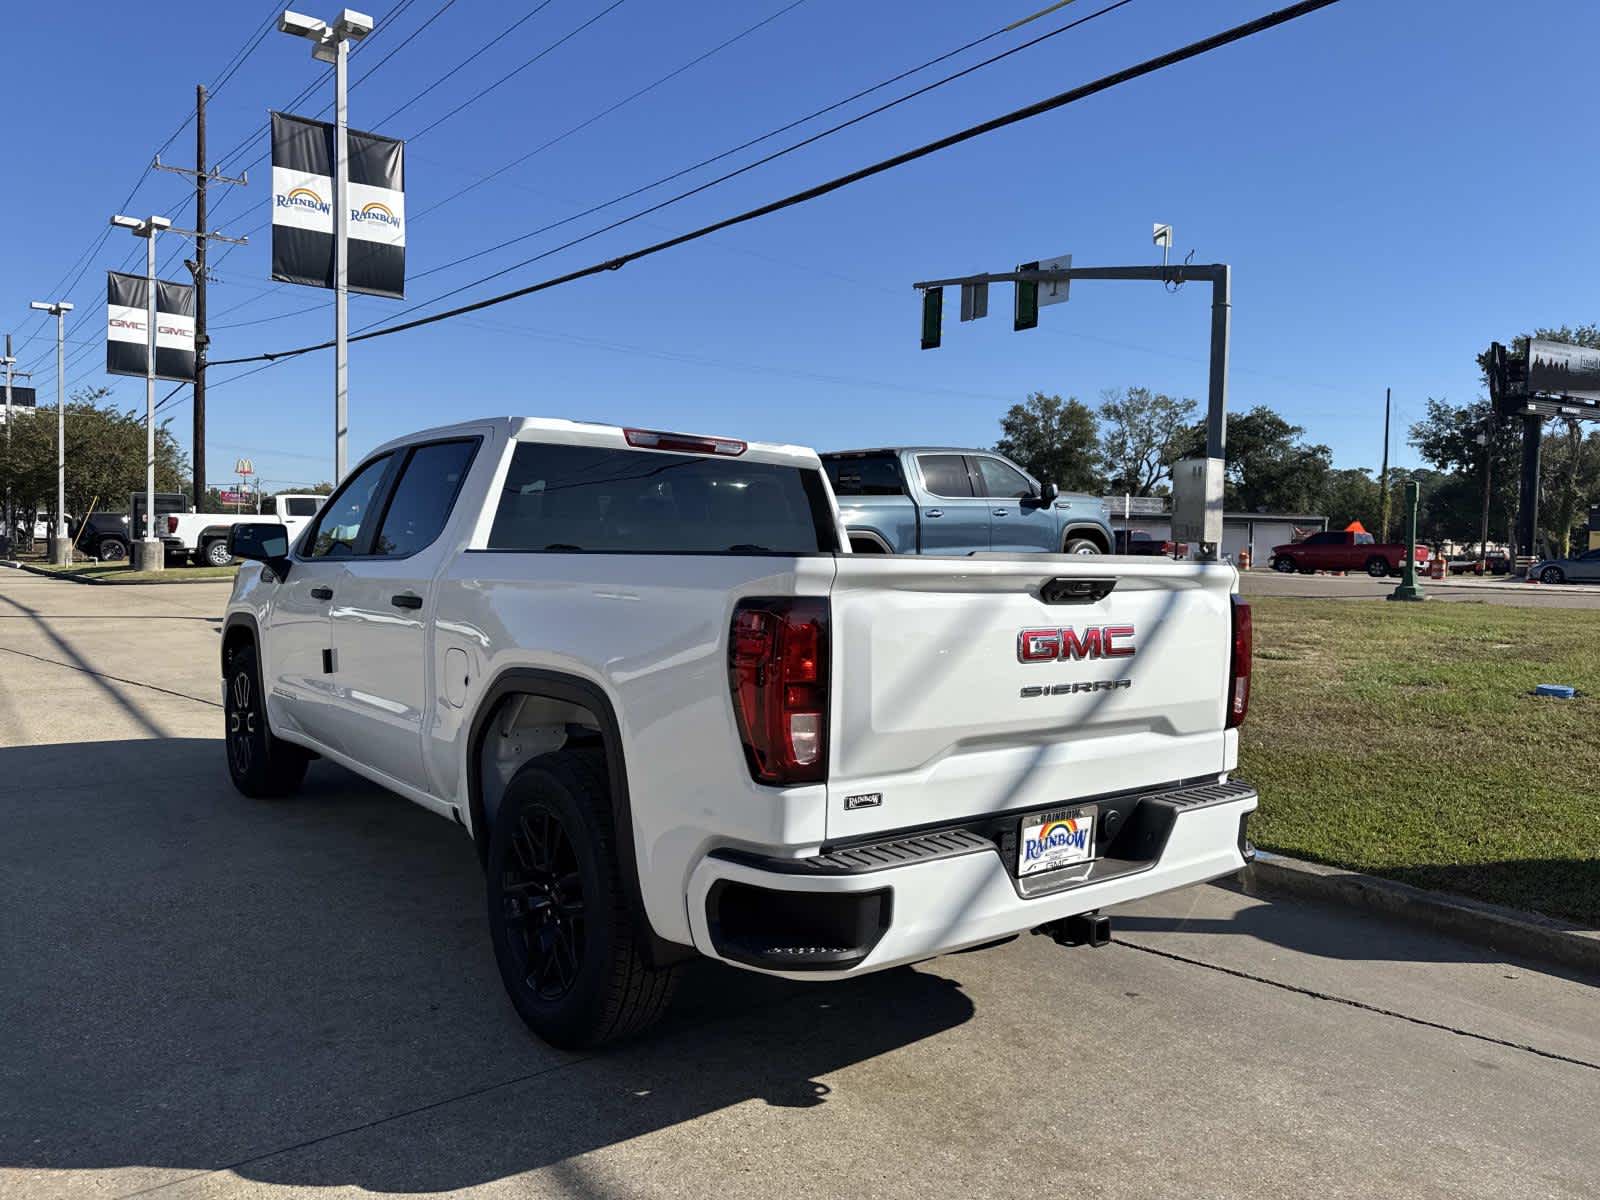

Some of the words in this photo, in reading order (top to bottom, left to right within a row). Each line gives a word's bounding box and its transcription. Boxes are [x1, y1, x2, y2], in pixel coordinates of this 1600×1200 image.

[276, 194, 331, 216] RAINBOW
[350, 208, 401, 229] RAINBOW
[109, 319, 147, 331] GMC
[158, 326, 193, 338] GMC
[1017, 624, 1136, 664] GMC
[1020, 679, 1132, 698] SIERRA
[1040, 809, 1080, 824] RAINBOW
[1026, 829, 1088, 860] RAINBOW
